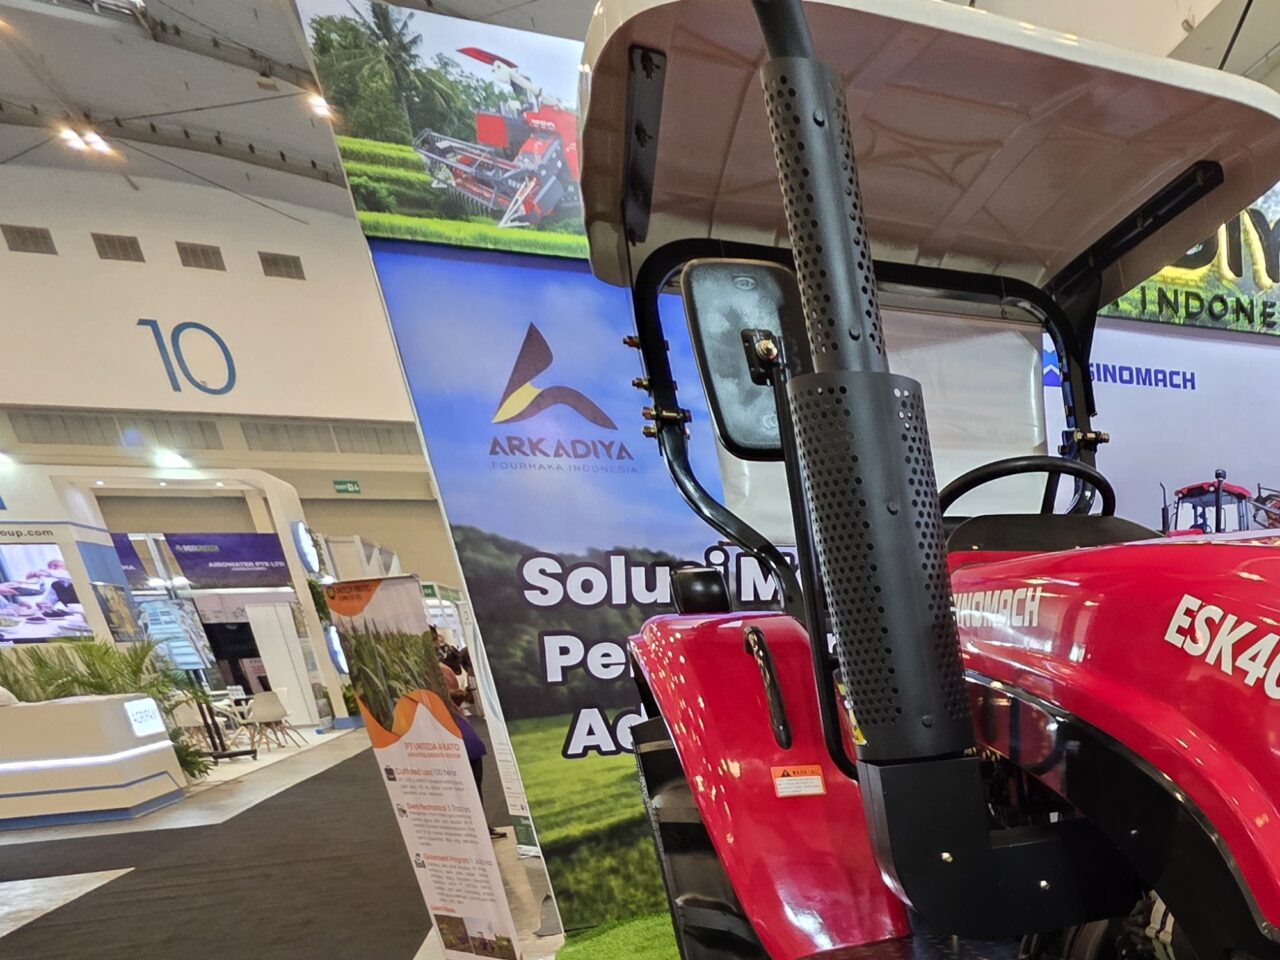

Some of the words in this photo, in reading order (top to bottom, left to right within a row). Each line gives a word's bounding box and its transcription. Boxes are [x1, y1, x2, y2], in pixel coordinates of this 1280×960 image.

[136, 318, 237, 396] 10
[489, 436, 635, 461] ARKADIYA
[491, 461, 564, 471] FOURHAKA
[568, 465, 640, 474] INDONESIA
[950, 586, 1043, 628] INOMACH
